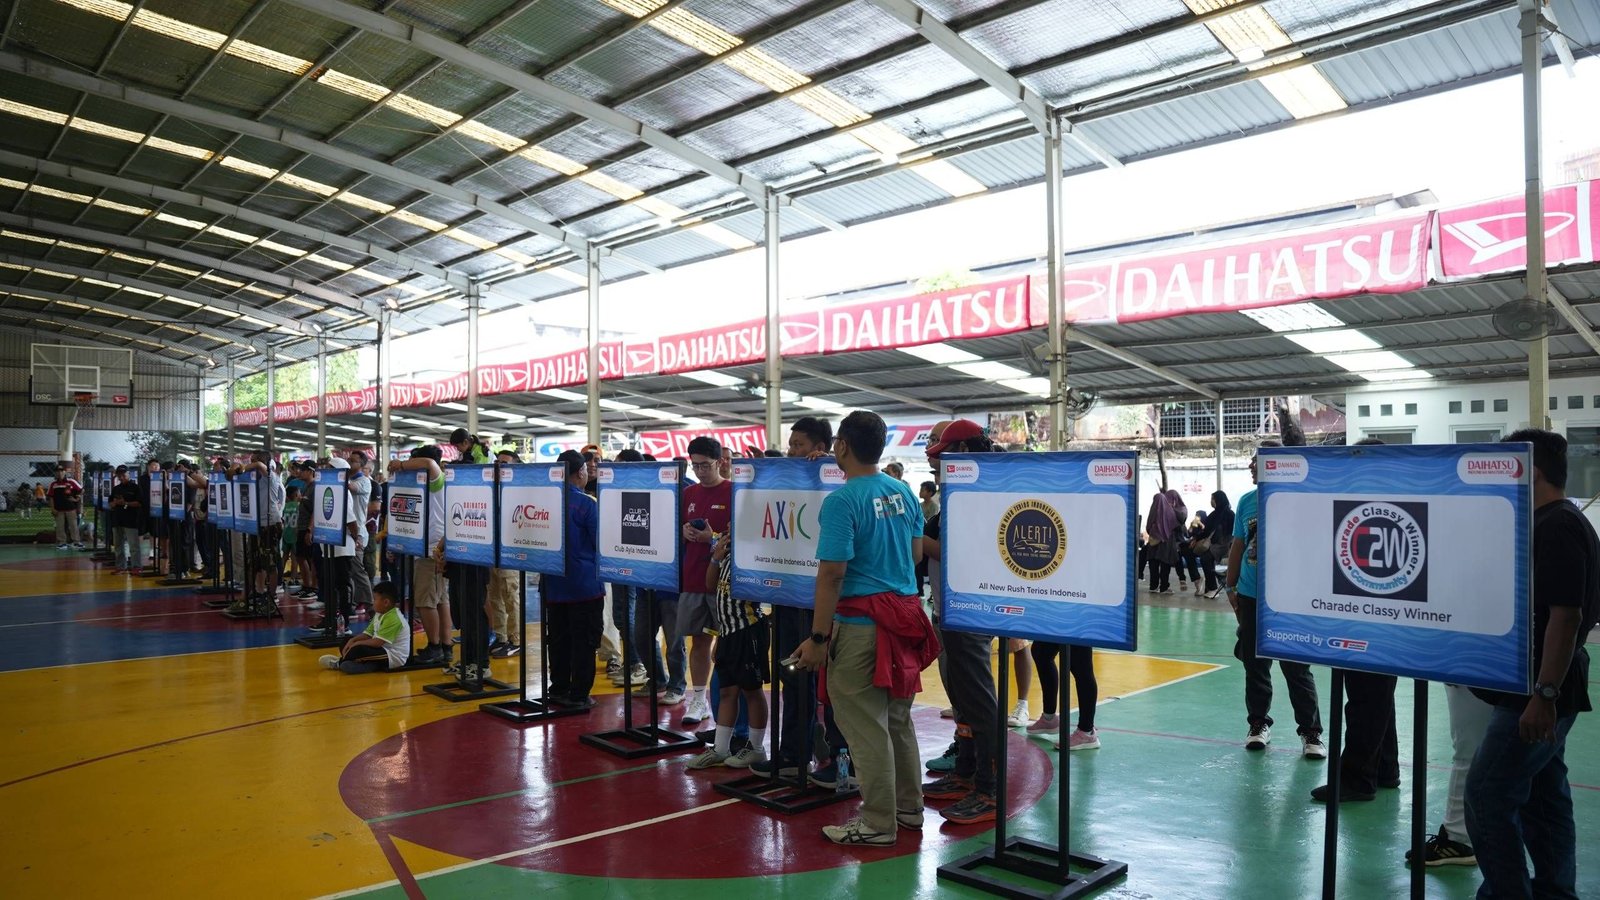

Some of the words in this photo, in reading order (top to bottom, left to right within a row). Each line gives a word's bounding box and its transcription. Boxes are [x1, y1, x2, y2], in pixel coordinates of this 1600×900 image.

[1123, 224, 1423, 315] DAIHATSU
[832, 283, 1025, 351] DAIHATSU
[661, 324, 767, 369] DAIHATSU
[532, 346, 621, 388] DAIHASU
[435, 368, 501, 403] DAIHTSU
[1094, 465, 1127, 473] DAIHATSU
[1467, 460, 1514, 470] DAIHATSU
[523, 504, 549, 520] Ceria
[1013, 525, 1052, 543] ALERT!
[1340, 516, 1360, 567] Charade
[1362, 507, 1405, 523] Classy
[1405, 522, 1419, 571] Winner
[1352, 526, 1407, 569] C2W
[783, 558, 805, 566] Indonesia
[1005, 557, 1028, 577] FREEDOM
[1030, 560, 1059, 579] UNLIMITED
[978, 582, 988, 590] All
[1007, 585, 1025, 593] Rush
[1027, 586, 1048, 595] Terios
[1049, 588, 1087, 598] Indonesia
[1350, 569, 1408, 590] Community
[949, 600, 982, 610] Supported
[983, 602, 991, 612] by
[1311, 598, 1359, 614] Charade
[1363, 603, 1400, 620] Classy
[1403, 607, 1452, 623] Winner
[1266, 629, 1310, 642] Supported
[1312, 634, 1324, 647] by
